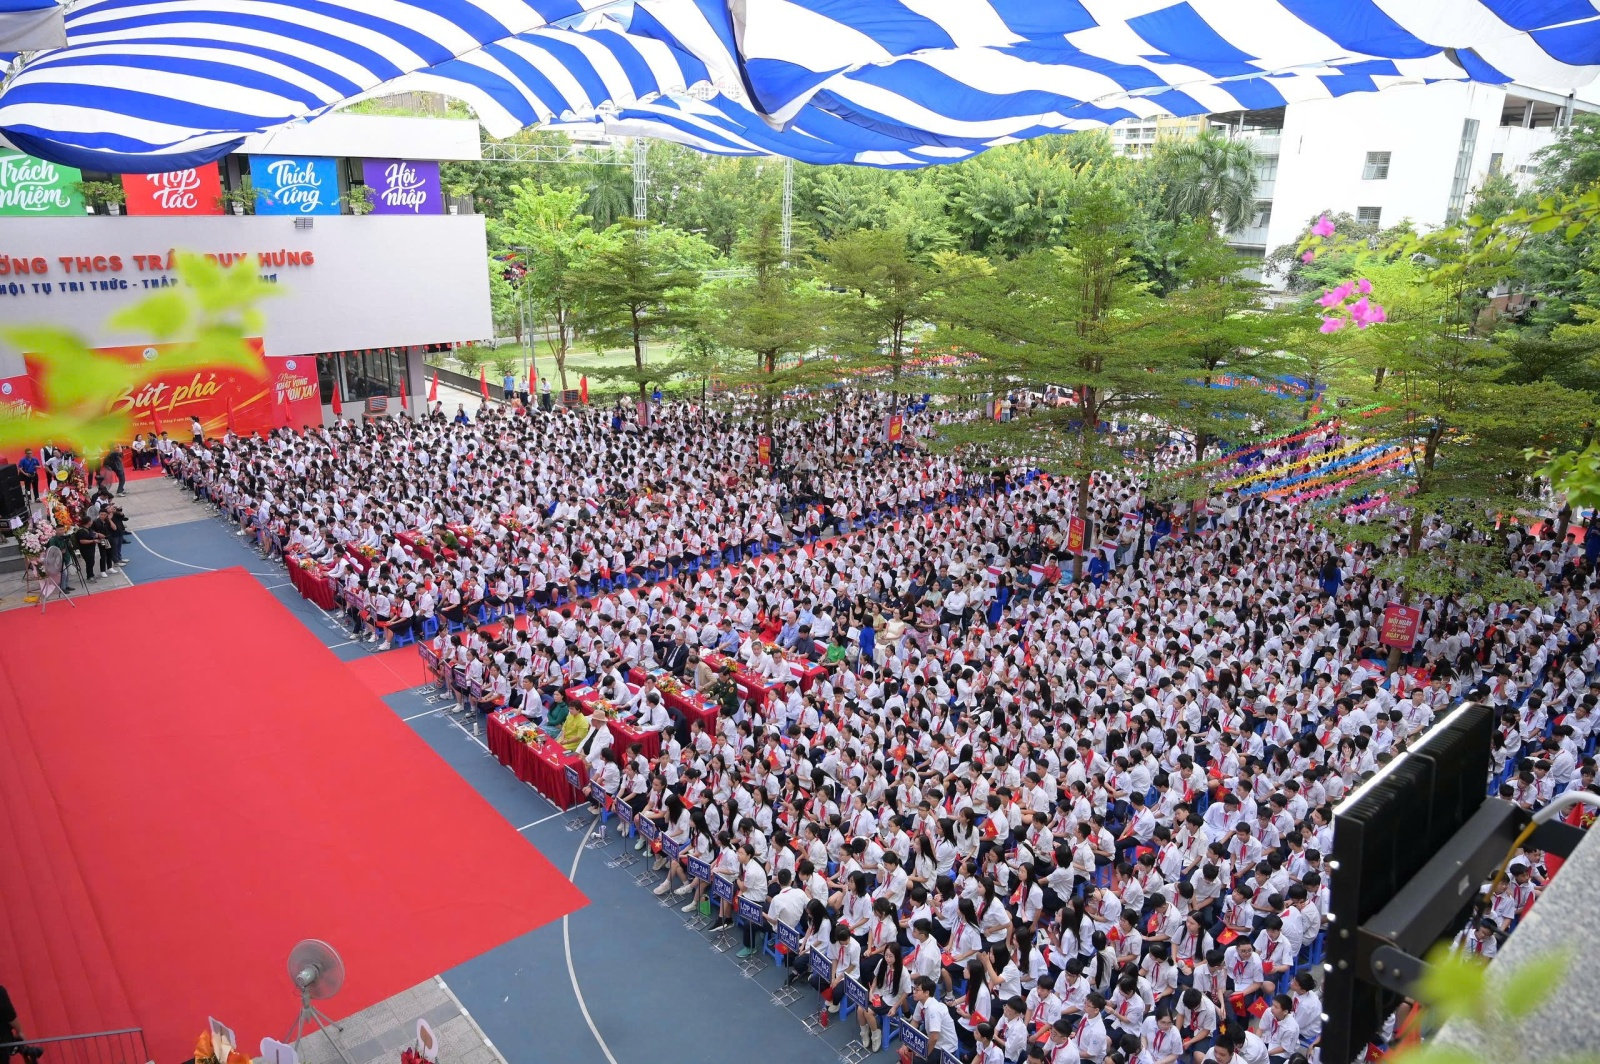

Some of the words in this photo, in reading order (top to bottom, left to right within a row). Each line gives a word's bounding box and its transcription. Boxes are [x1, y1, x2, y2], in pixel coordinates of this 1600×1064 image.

[267, 160, 321, 187] Thích
[385, 162, 426, 189] Hội
[153, 188, 198, 209] tác
[275, 185, 323, 212] ứng
[381, 188, 427, 213] nhập
[59, 255, 123, 273] THCS
[258, 249, 314, 268] HƯNG
[32, 282, 52, 295] TỤ
[59, 281, 84, 292] TRI
[90, 277, 127, 291] THỨC
[106, 383, 170, 416] Bứt
[168, 372, 226, 415] phá
[902, 1027, 914, 1040] LỚP
